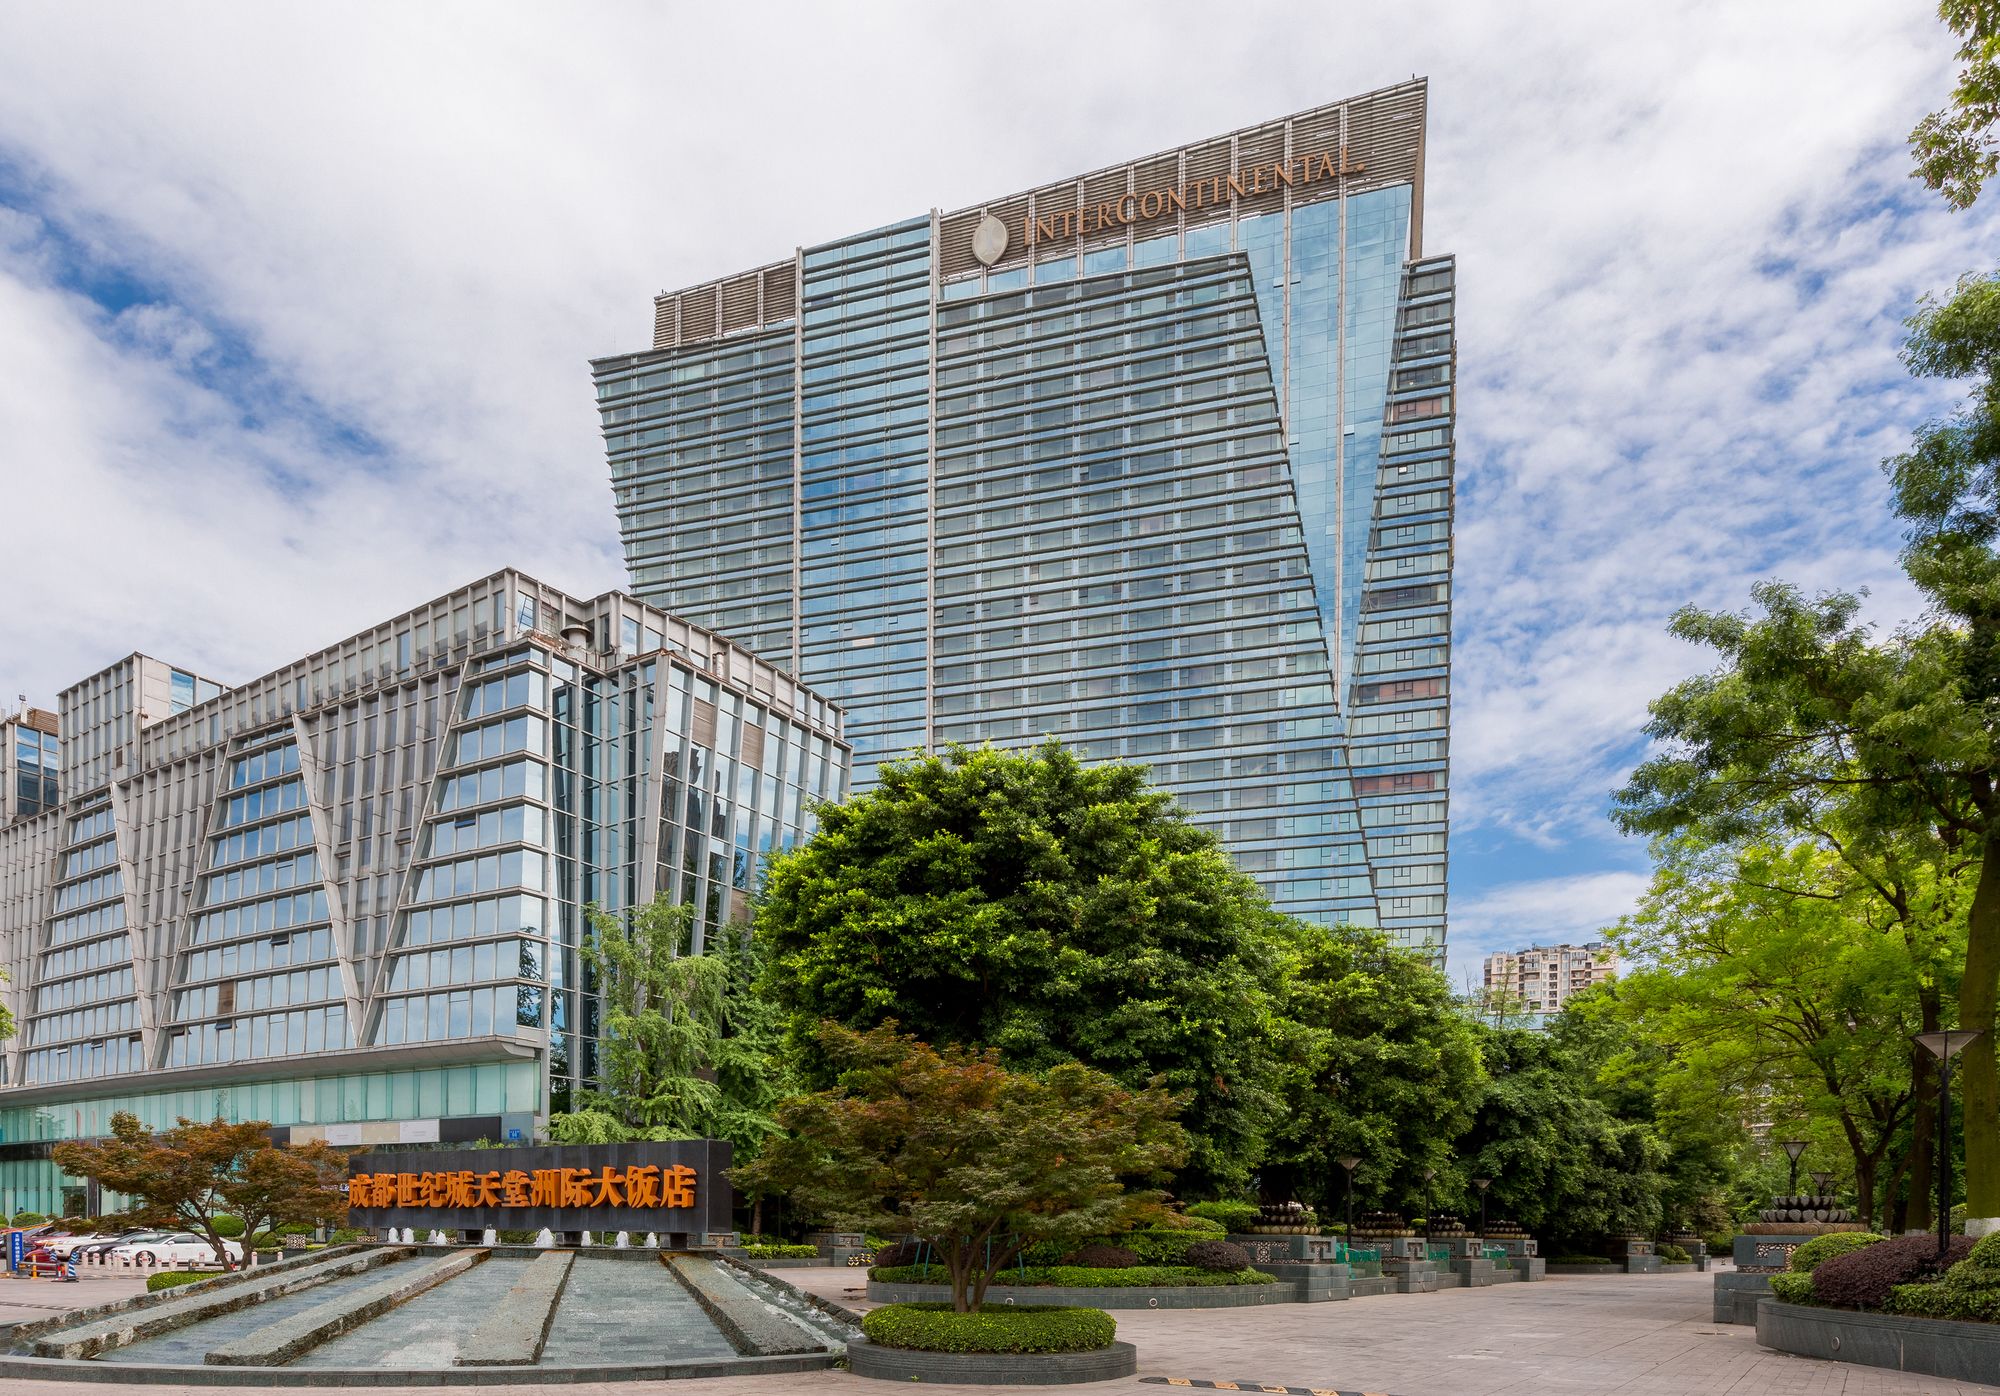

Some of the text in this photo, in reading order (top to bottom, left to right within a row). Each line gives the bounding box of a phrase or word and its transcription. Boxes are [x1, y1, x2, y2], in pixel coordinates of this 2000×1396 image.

[348, 1164, 698, 1209] 成都世纪城天堂洲际大饭店
